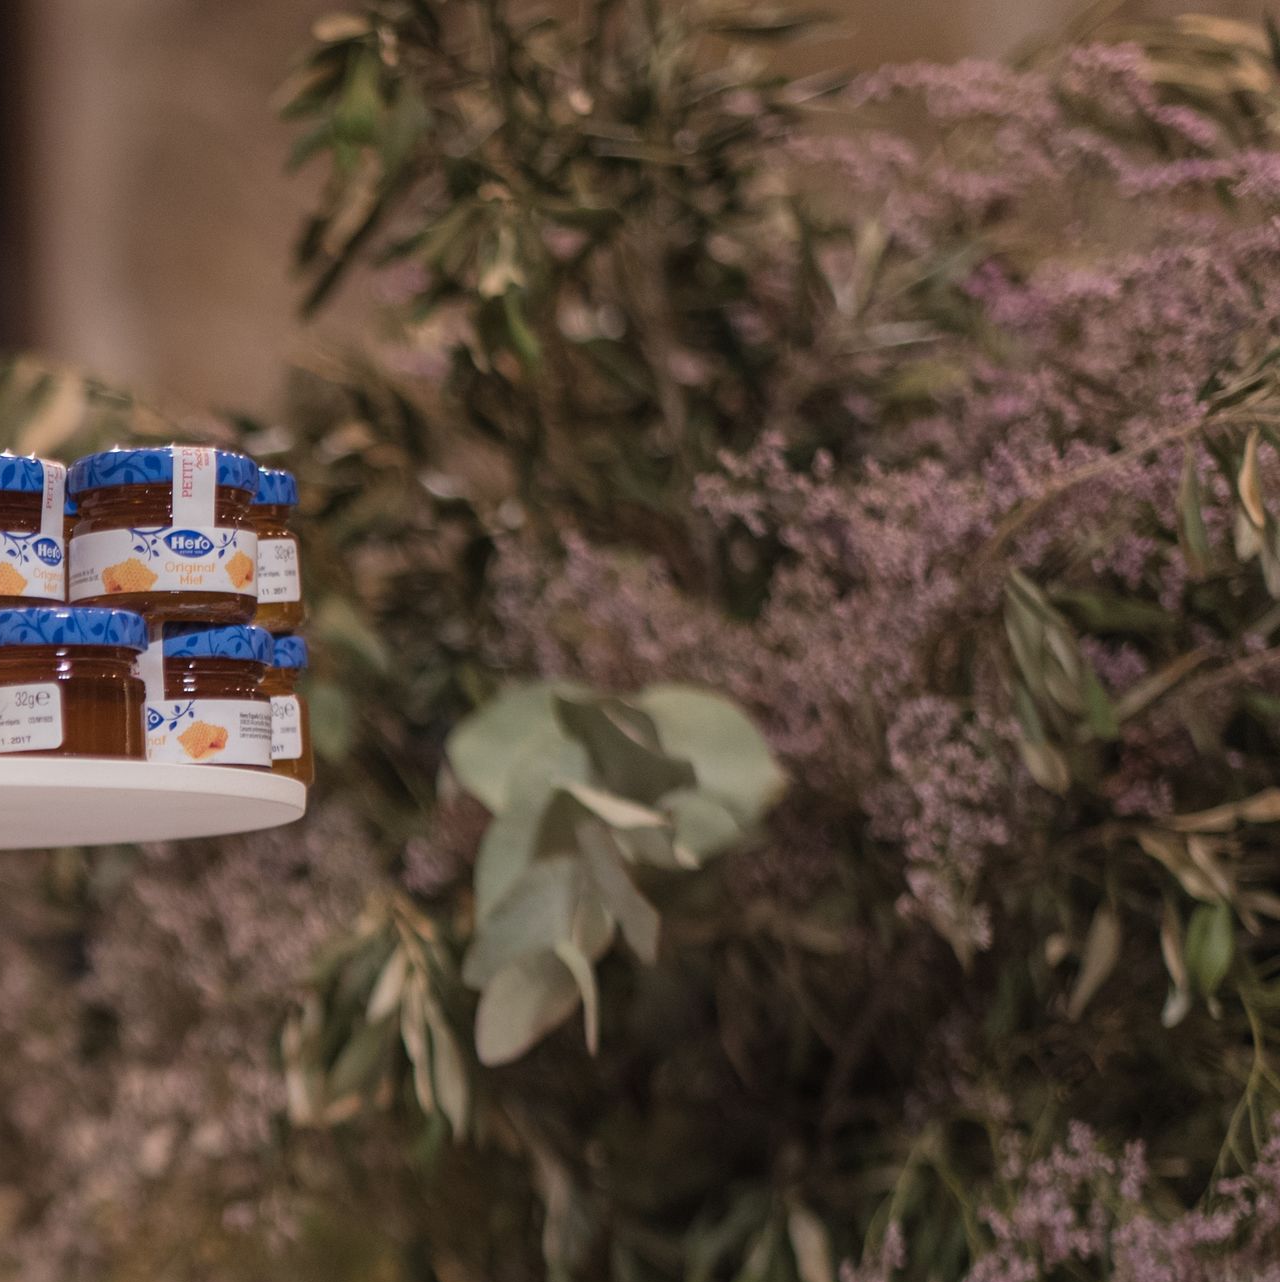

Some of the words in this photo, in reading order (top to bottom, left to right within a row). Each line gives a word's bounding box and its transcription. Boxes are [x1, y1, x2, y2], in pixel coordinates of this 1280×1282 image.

[170, 536, 210, 550] Hero
[37, 543, 61, 559] Hero
[164, 562, 216, 575] Original
[179, 575, 203, 586] Miel
